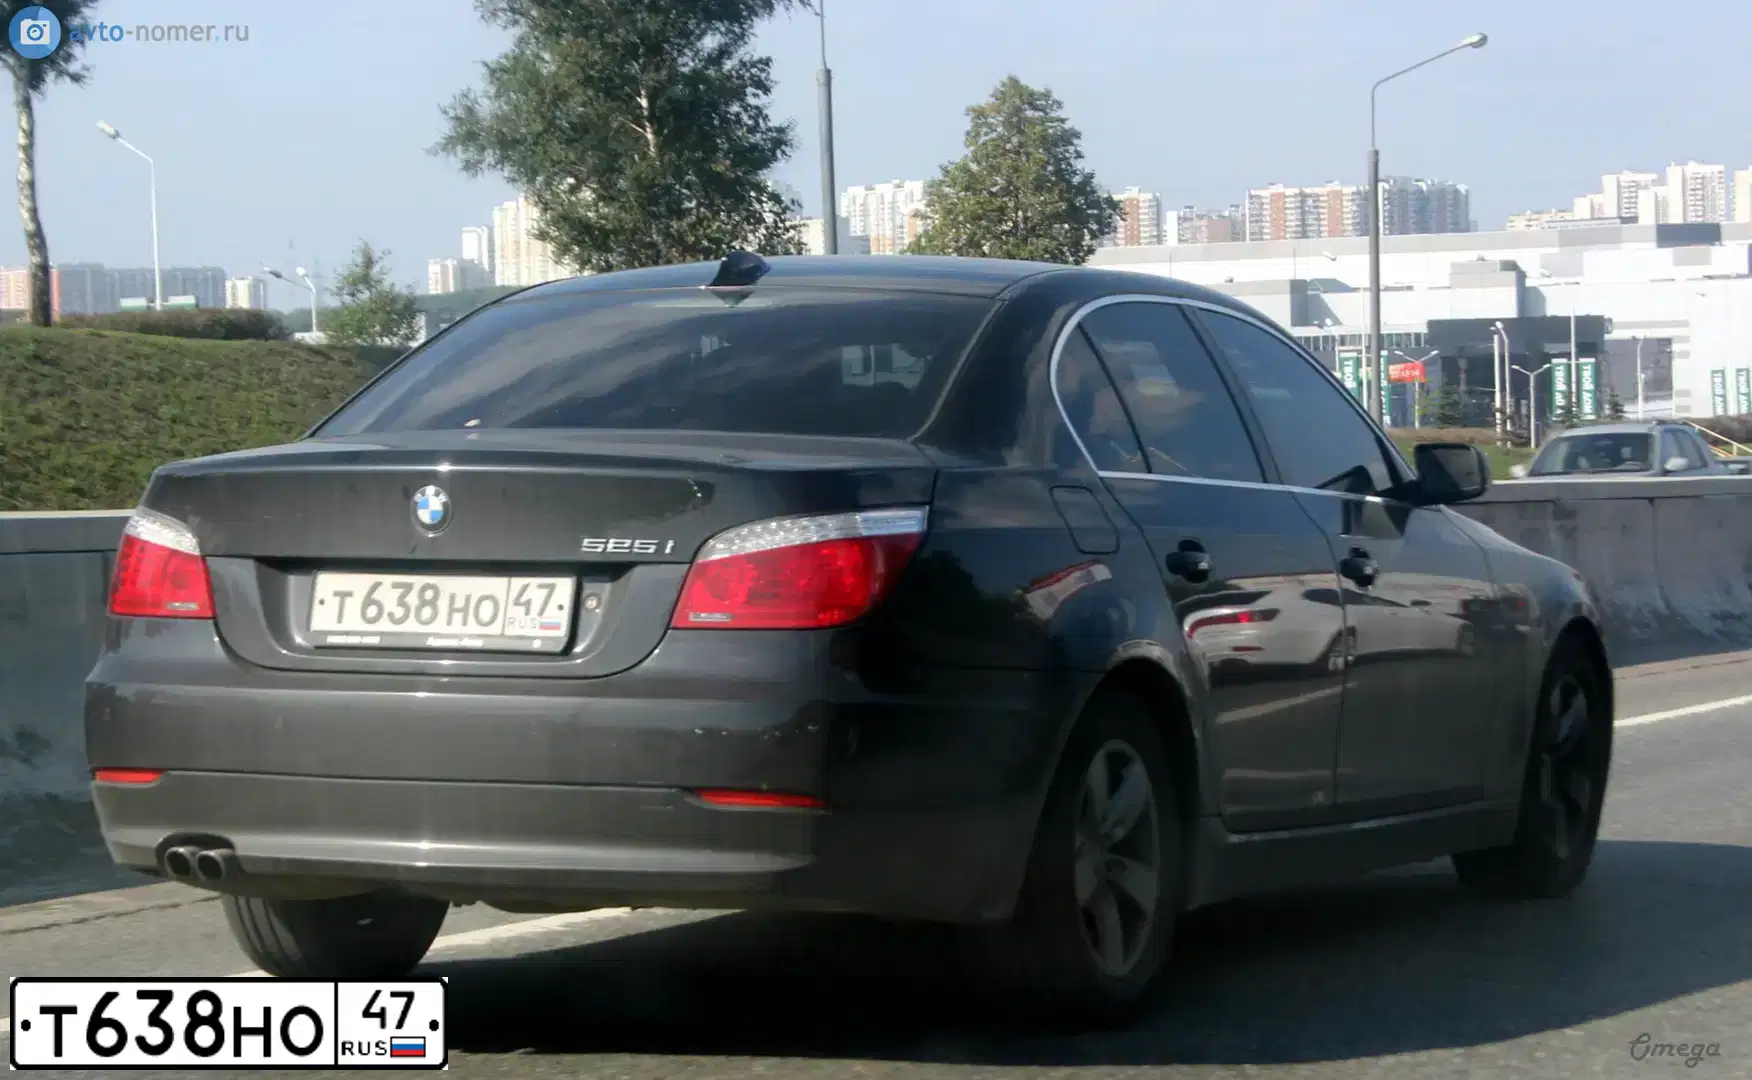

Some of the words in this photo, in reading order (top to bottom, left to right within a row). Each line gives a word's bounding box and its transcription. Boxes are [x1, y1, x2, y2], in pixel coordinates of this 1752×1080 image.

[1555, 365, 1568, 391] ТВОЙ
[1582, 364, 1594, 390] ТВОЙ
[512, 582, 557, 617] 47
[508, 616, 538, 629] RUS
